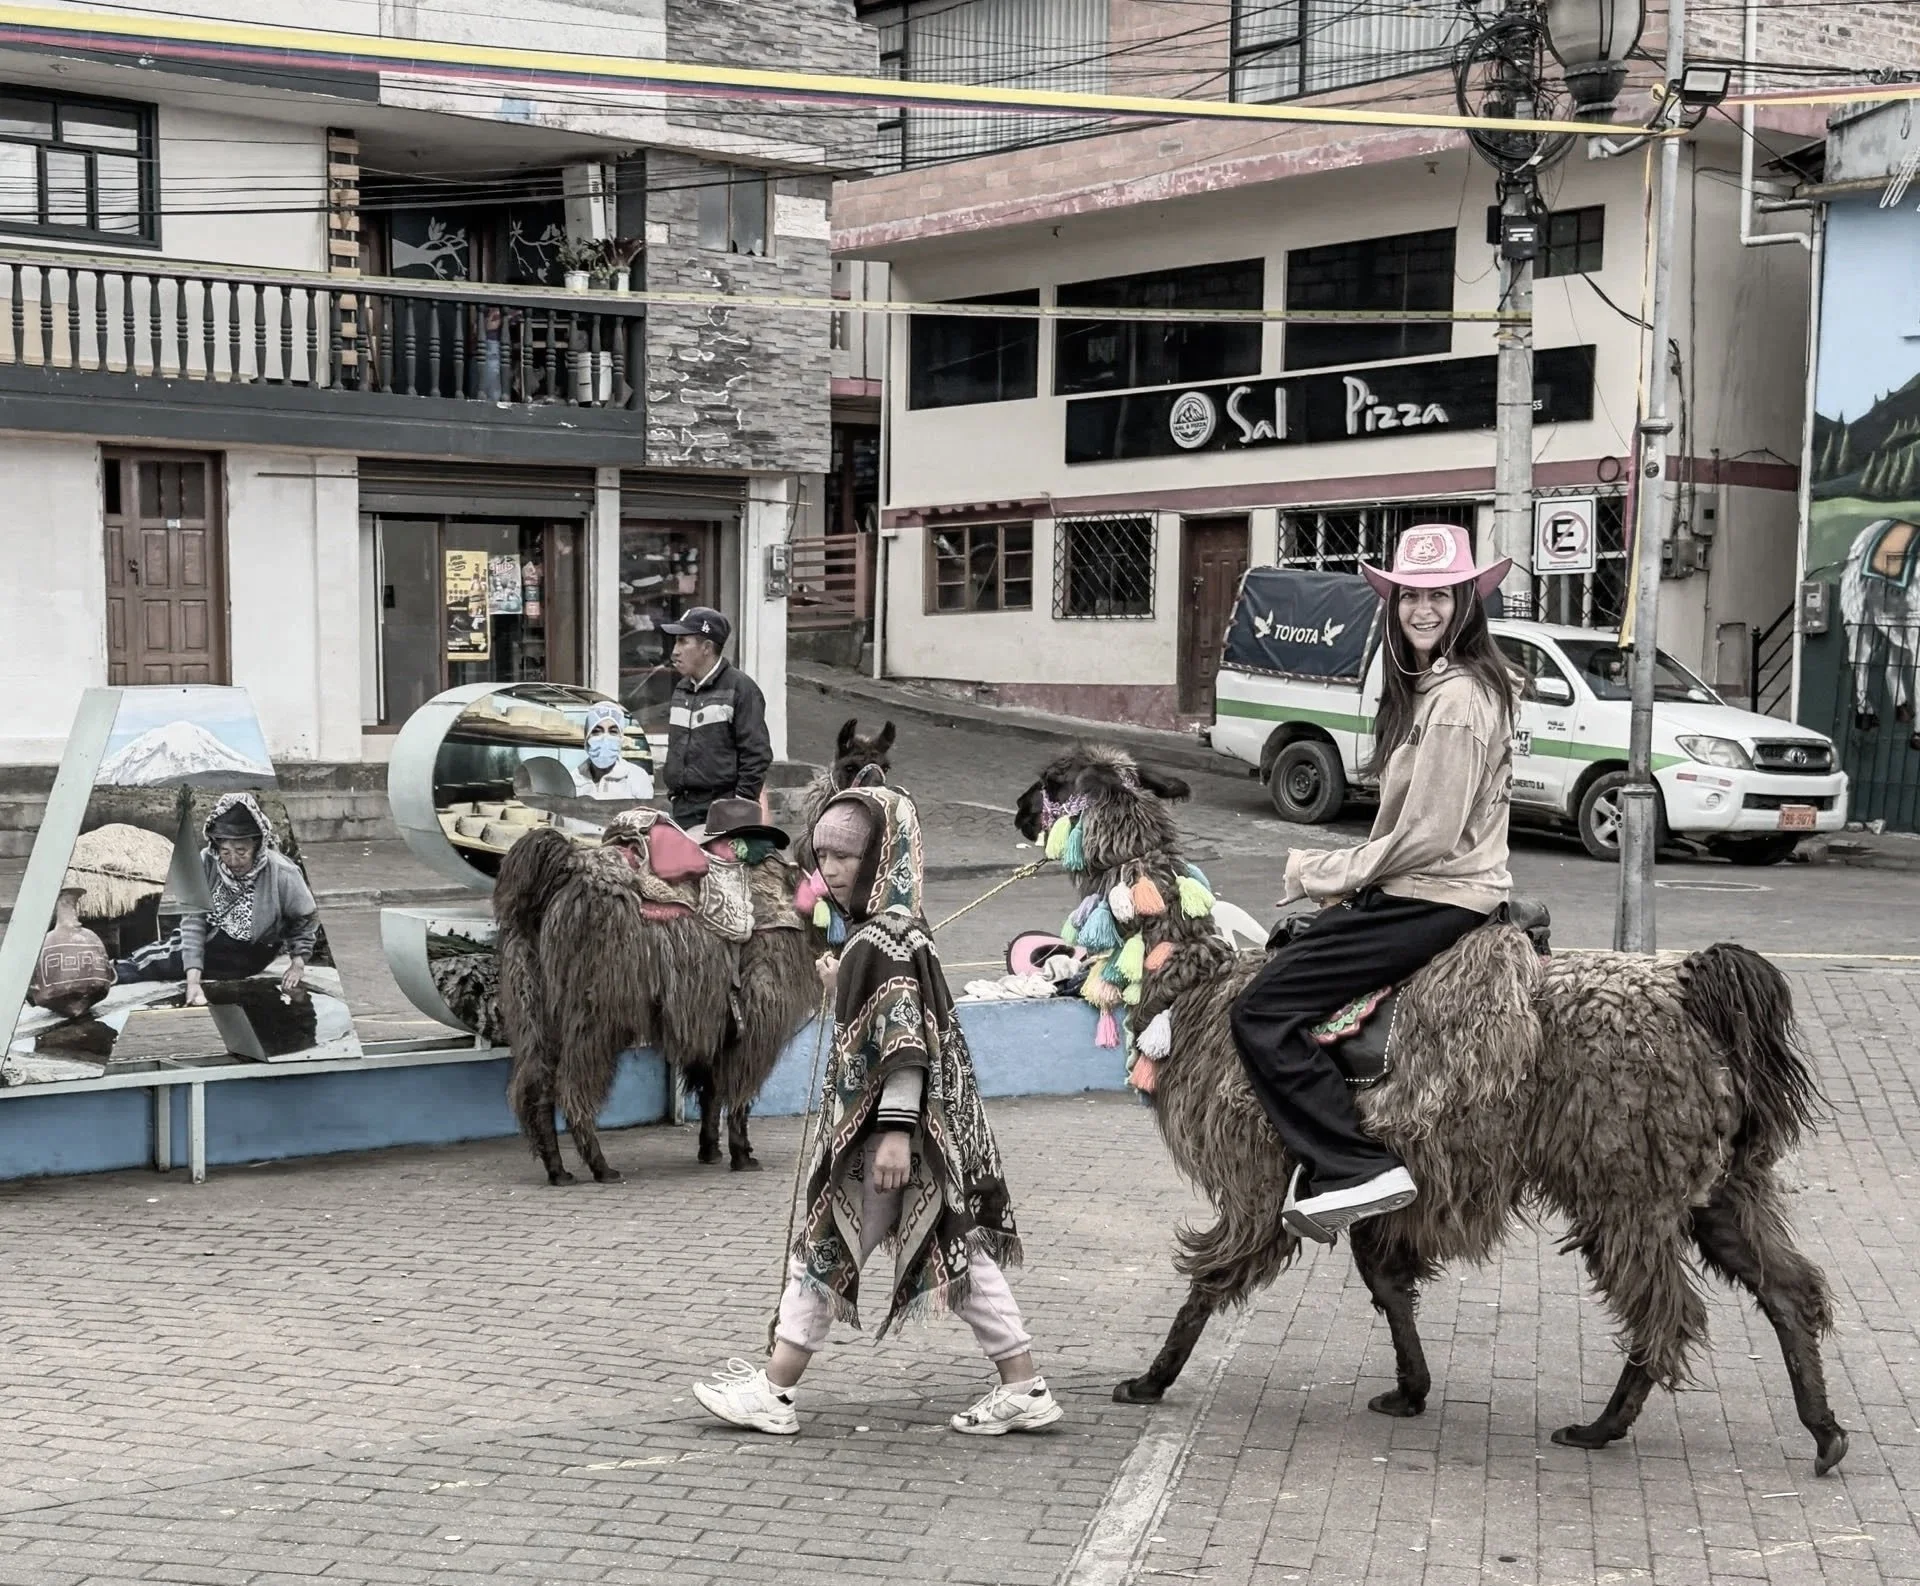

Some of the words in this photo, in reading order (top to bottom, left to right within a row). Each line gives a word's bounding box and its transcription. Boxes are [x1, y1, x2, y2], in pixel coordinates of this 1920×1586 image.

[1227, 385, 1288, 444] Sal
[1342, 375, 1449, 436] Pizza
[1552, 519, 1576, 552] E
[1274, 624, 1318, 645] TOYOTA
